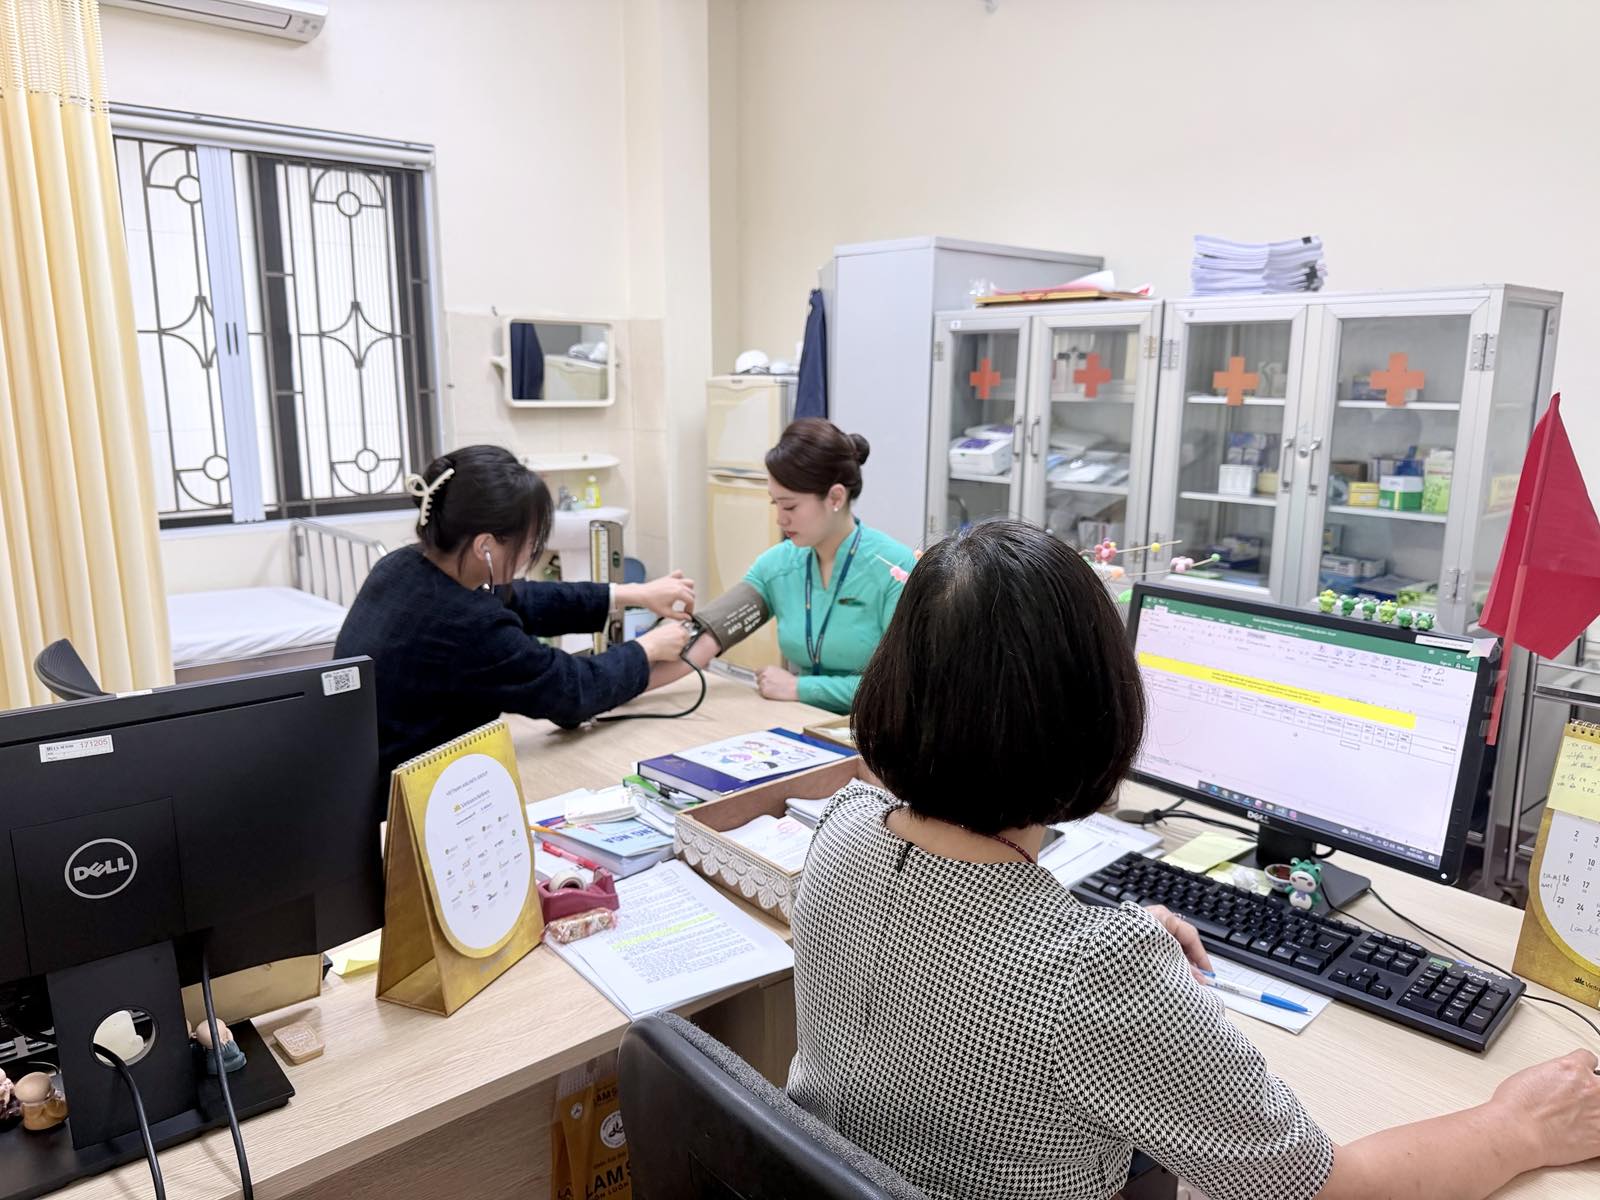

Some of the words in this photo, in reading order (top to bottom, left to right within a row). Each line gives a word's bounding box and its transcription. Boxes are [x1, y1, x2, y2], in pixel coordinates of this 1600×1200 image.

[1574, 830, 1580, 838] 2
[1594, 836, 1600, 844] 3
[1569, 852, 1574, 860] 9
[1588, 858, 1596, 867] 10
[73, 857, 130, 882] DELL
[1563, 874, 1570, 882] 16
[1582, 880, 1590, 889] 17
[1556, 896, 1565, 904] 23
[1576, 903, 1584, 911] 24
